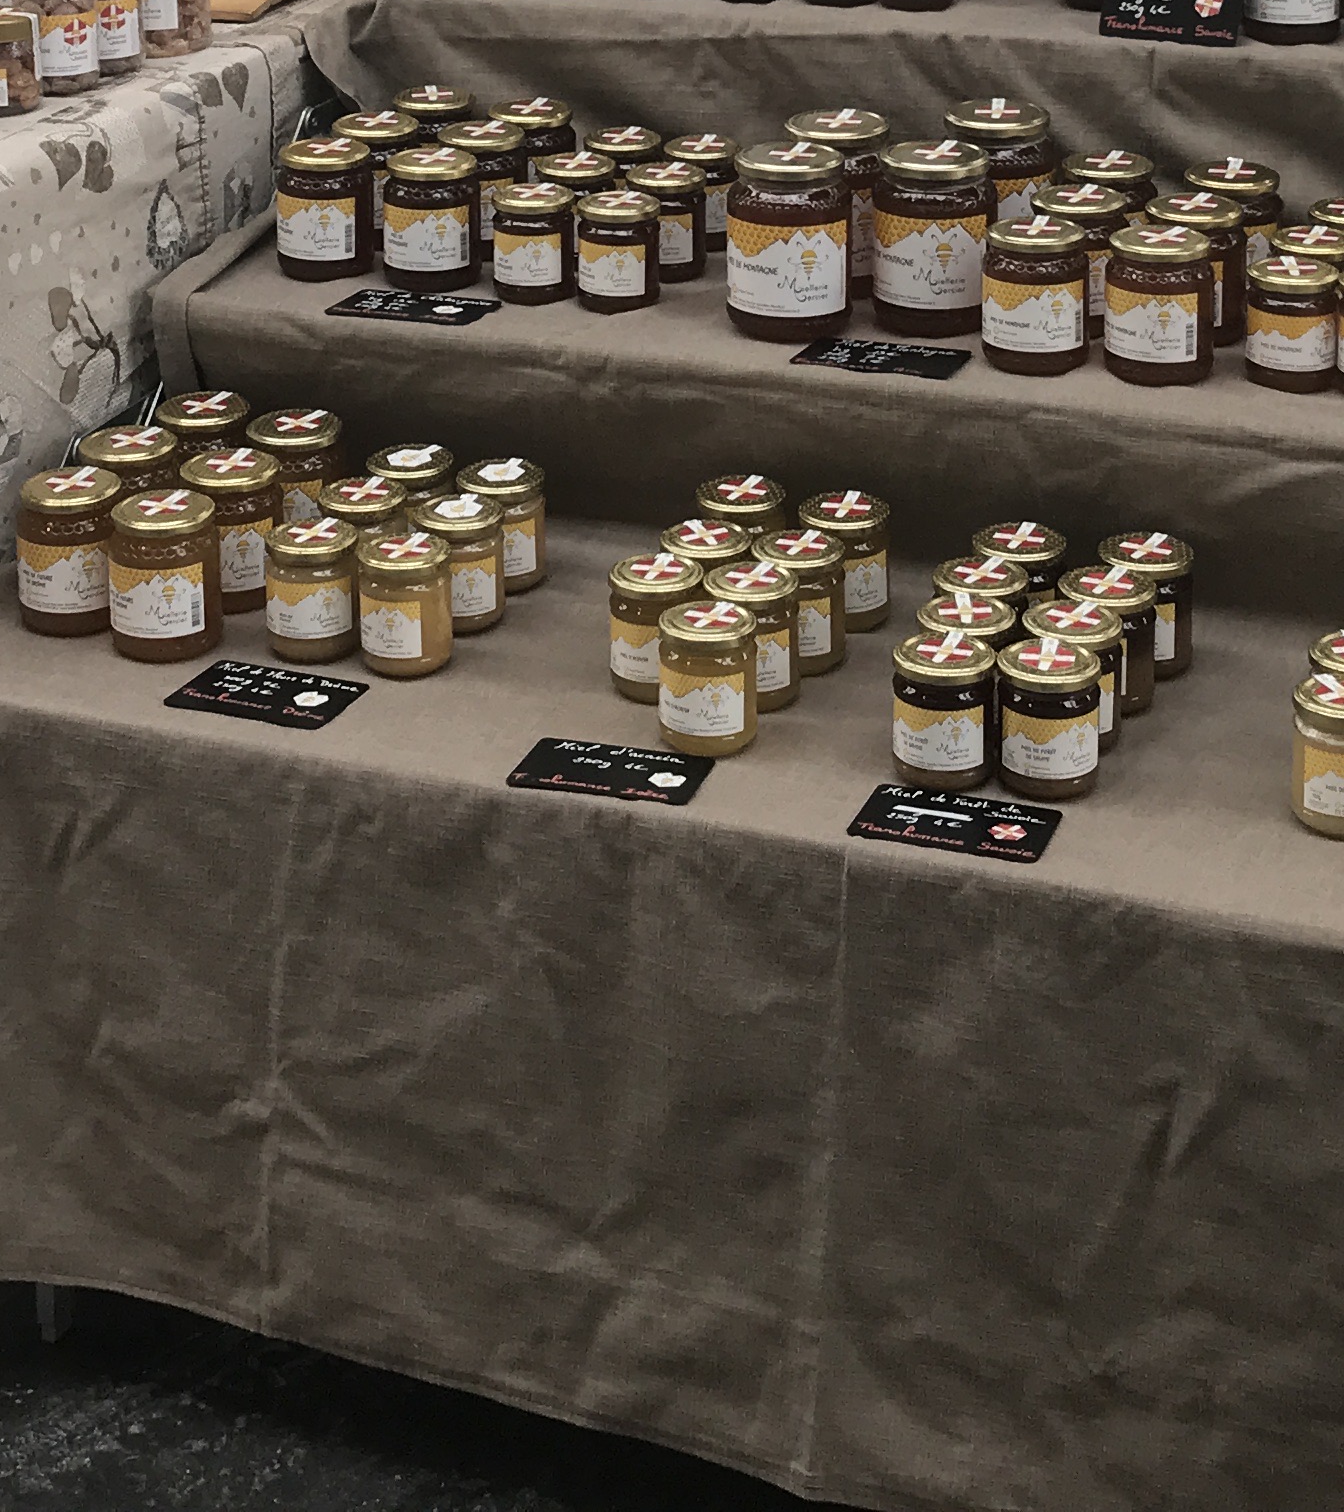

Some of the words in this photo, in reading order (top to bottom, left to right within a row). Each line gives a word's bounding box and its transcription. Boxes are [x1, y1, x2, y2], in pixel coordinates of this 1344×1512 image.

[1104, 15, 1183, 36] Transhumance
[1195, 24, 1235, 40] Savoie
[743, 262, 779, 276] MONTAGNE
[881, 251, 914, 268] MONTAGNE
[218, 662, 251, 673] Miel
[250, 666, 263, 675] de
[301, 676, 314, 684] de
[182, 687, 272, 711] Transhumance
[554, 741, 601, 752] Miel
[881, 786, 924, 799] Miel
[930, 793, 947, 803] de
[1000, 804, 1022, 814] de
[983, 811, 1047, 825] Savoie
[857, 821, 964, 846] Transhumance
[976, 842, 1036, 858] Savoie
